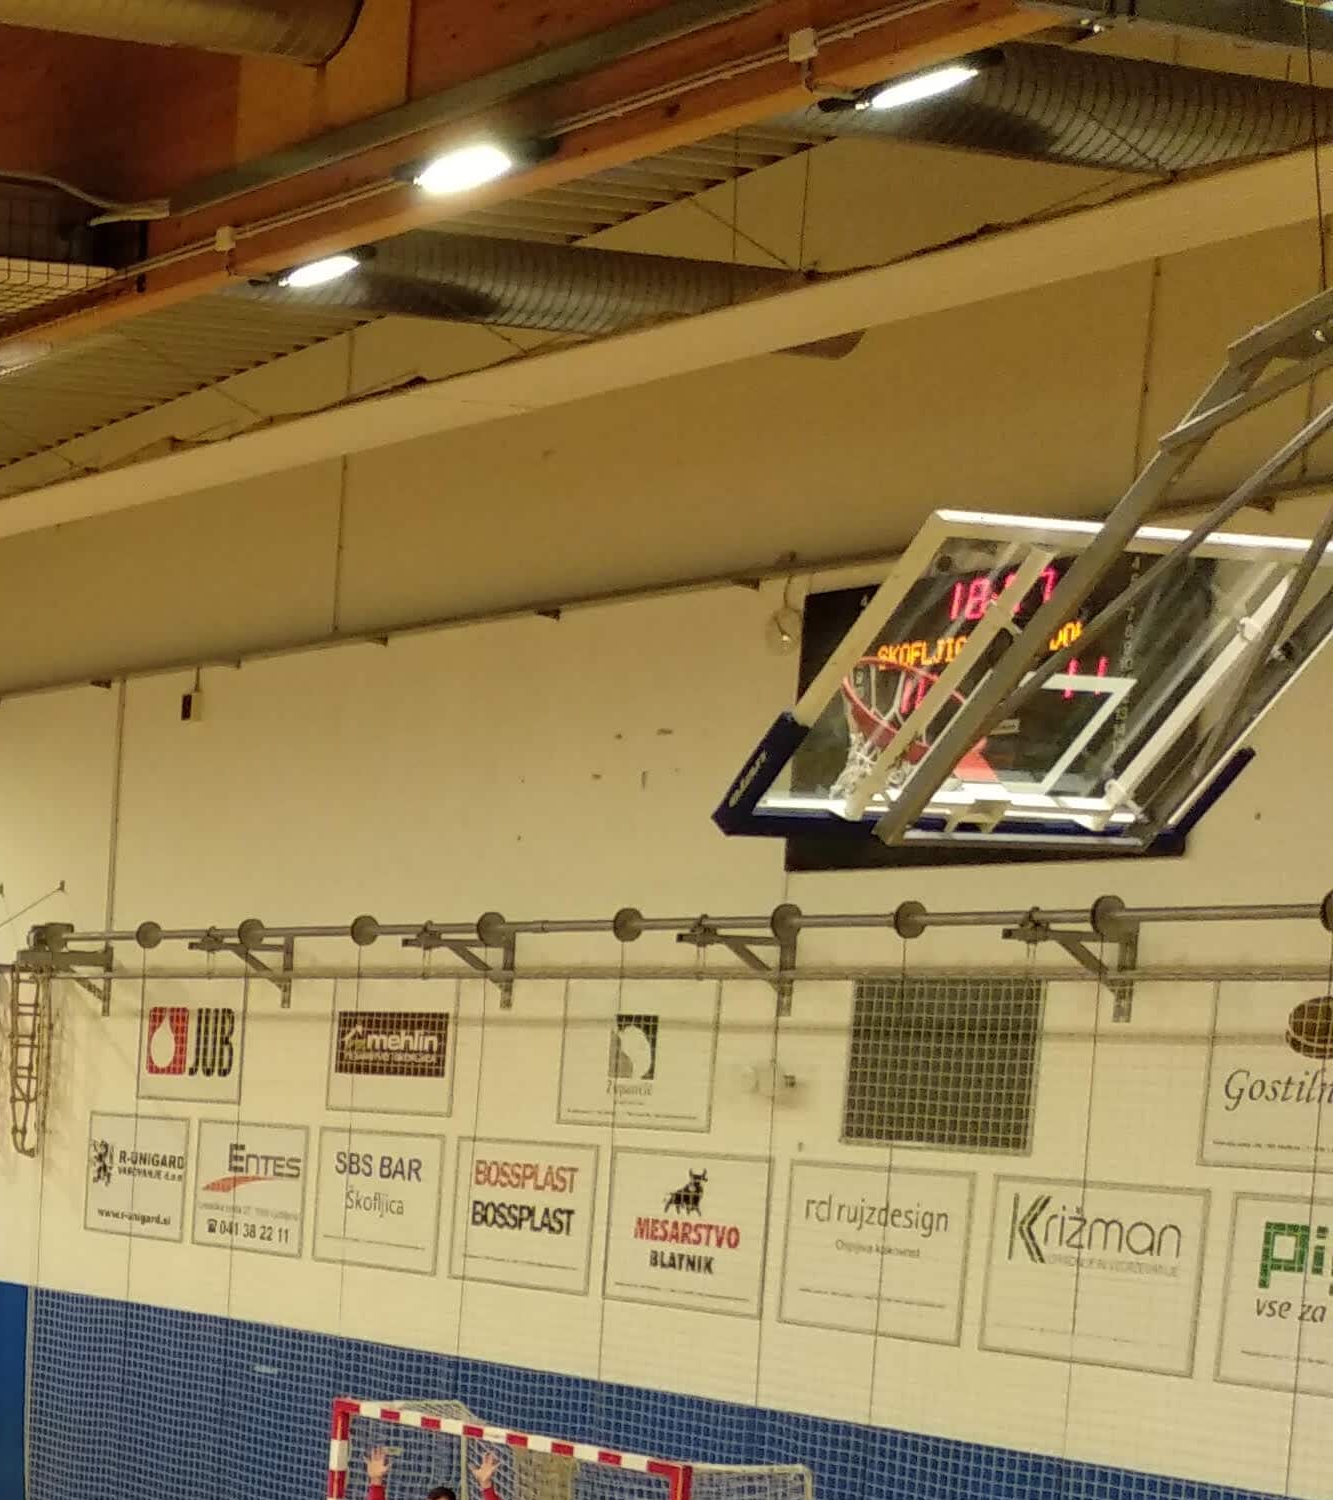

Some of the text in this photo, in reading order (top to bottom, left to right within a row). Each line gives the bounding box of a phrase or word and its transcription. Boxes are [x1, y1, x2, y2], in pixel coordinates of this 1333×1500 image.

[188, 1007, 235, 1077] JUB
[334, 1151, 423, 1183] SBS BAR
[474, 1159, 579, 1194] BOSSPLAST
[259, 1225, 274, 1242] 22
[278, 1227, 290, 1244] 11
[471, 1200, 576, 1236] BOSSPLAST
[634, 1216, 741, 1250] MESARSTVO
[1008, 1192, 1182, 1265] Križman
[649, 1249, 715, 1275] BLATNIK
[1256, 1298, 1327, 1323] vse za
